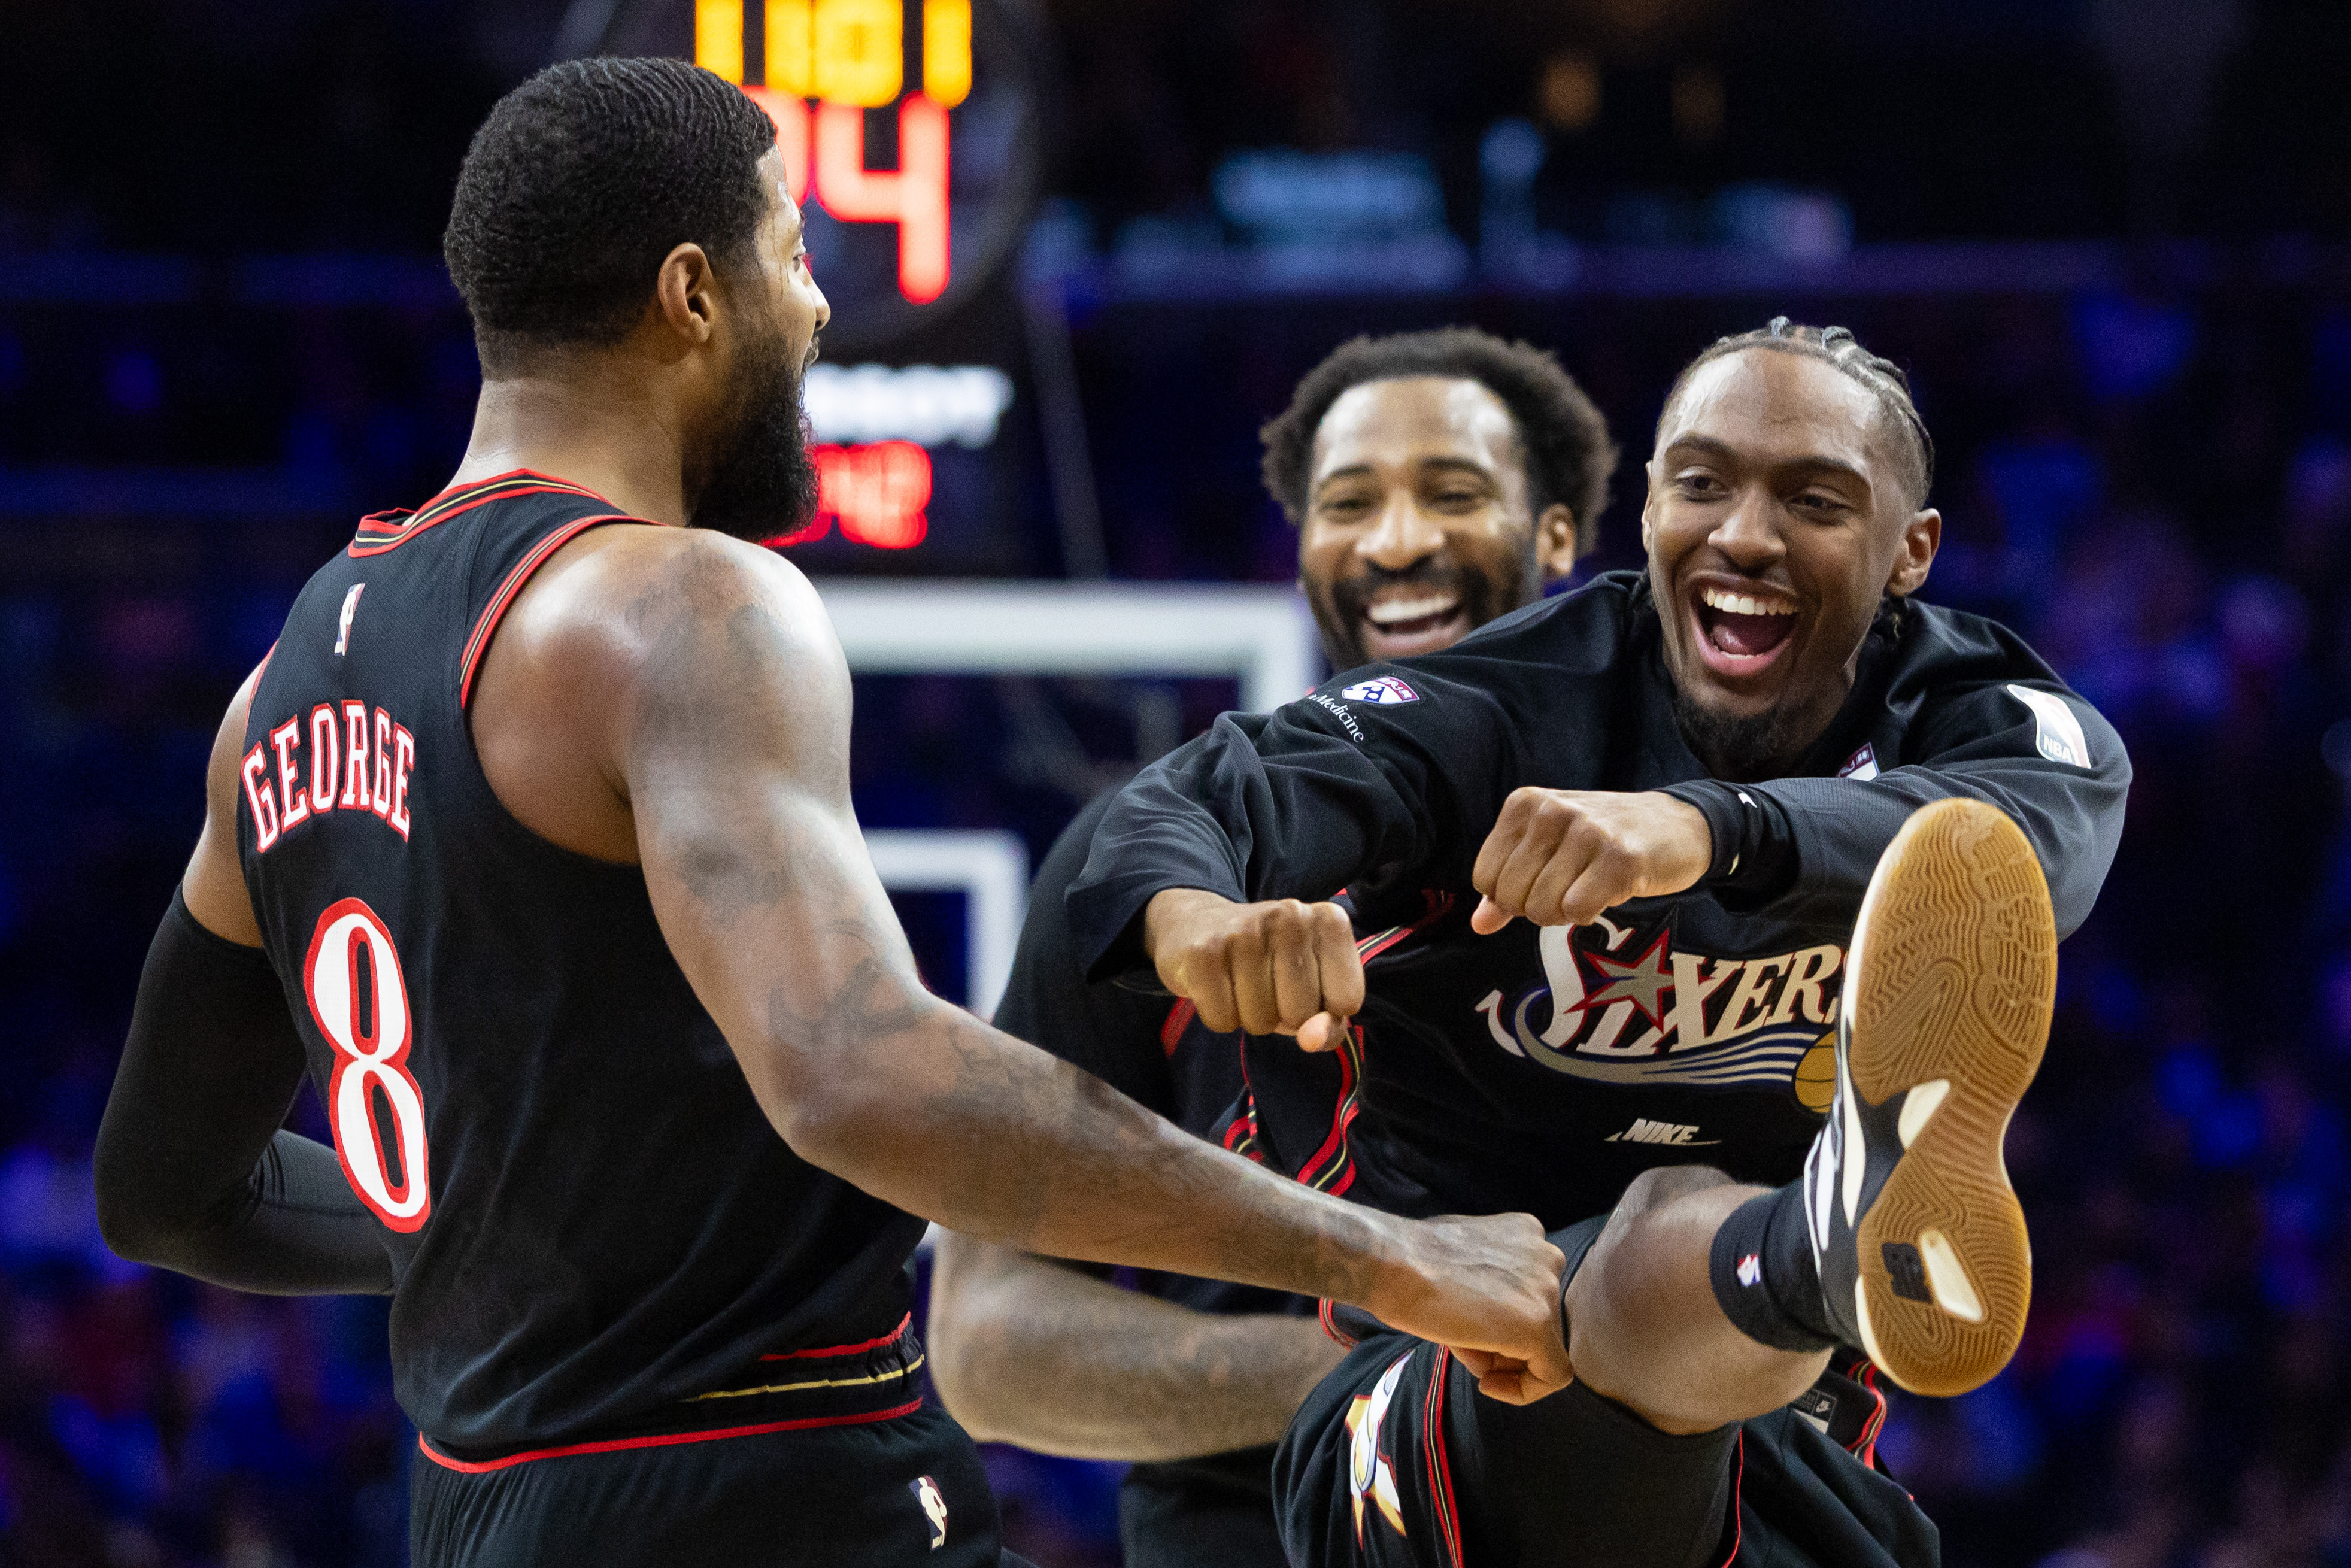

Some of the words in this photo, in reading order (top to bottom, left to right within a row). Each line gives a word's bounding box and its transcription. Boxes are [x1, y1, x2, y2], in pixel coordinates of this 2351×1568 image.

[1312, 694, 1364, 743] Medicine
[2043, 735, 2074, 765] NBA
[241, 699, 415, 853] GEORGE
[1474, 915, 1848, 1059] SIXER
[304, 897, 431, 1233] 8
[1621, 1117, 1701, 1144] NIKE
